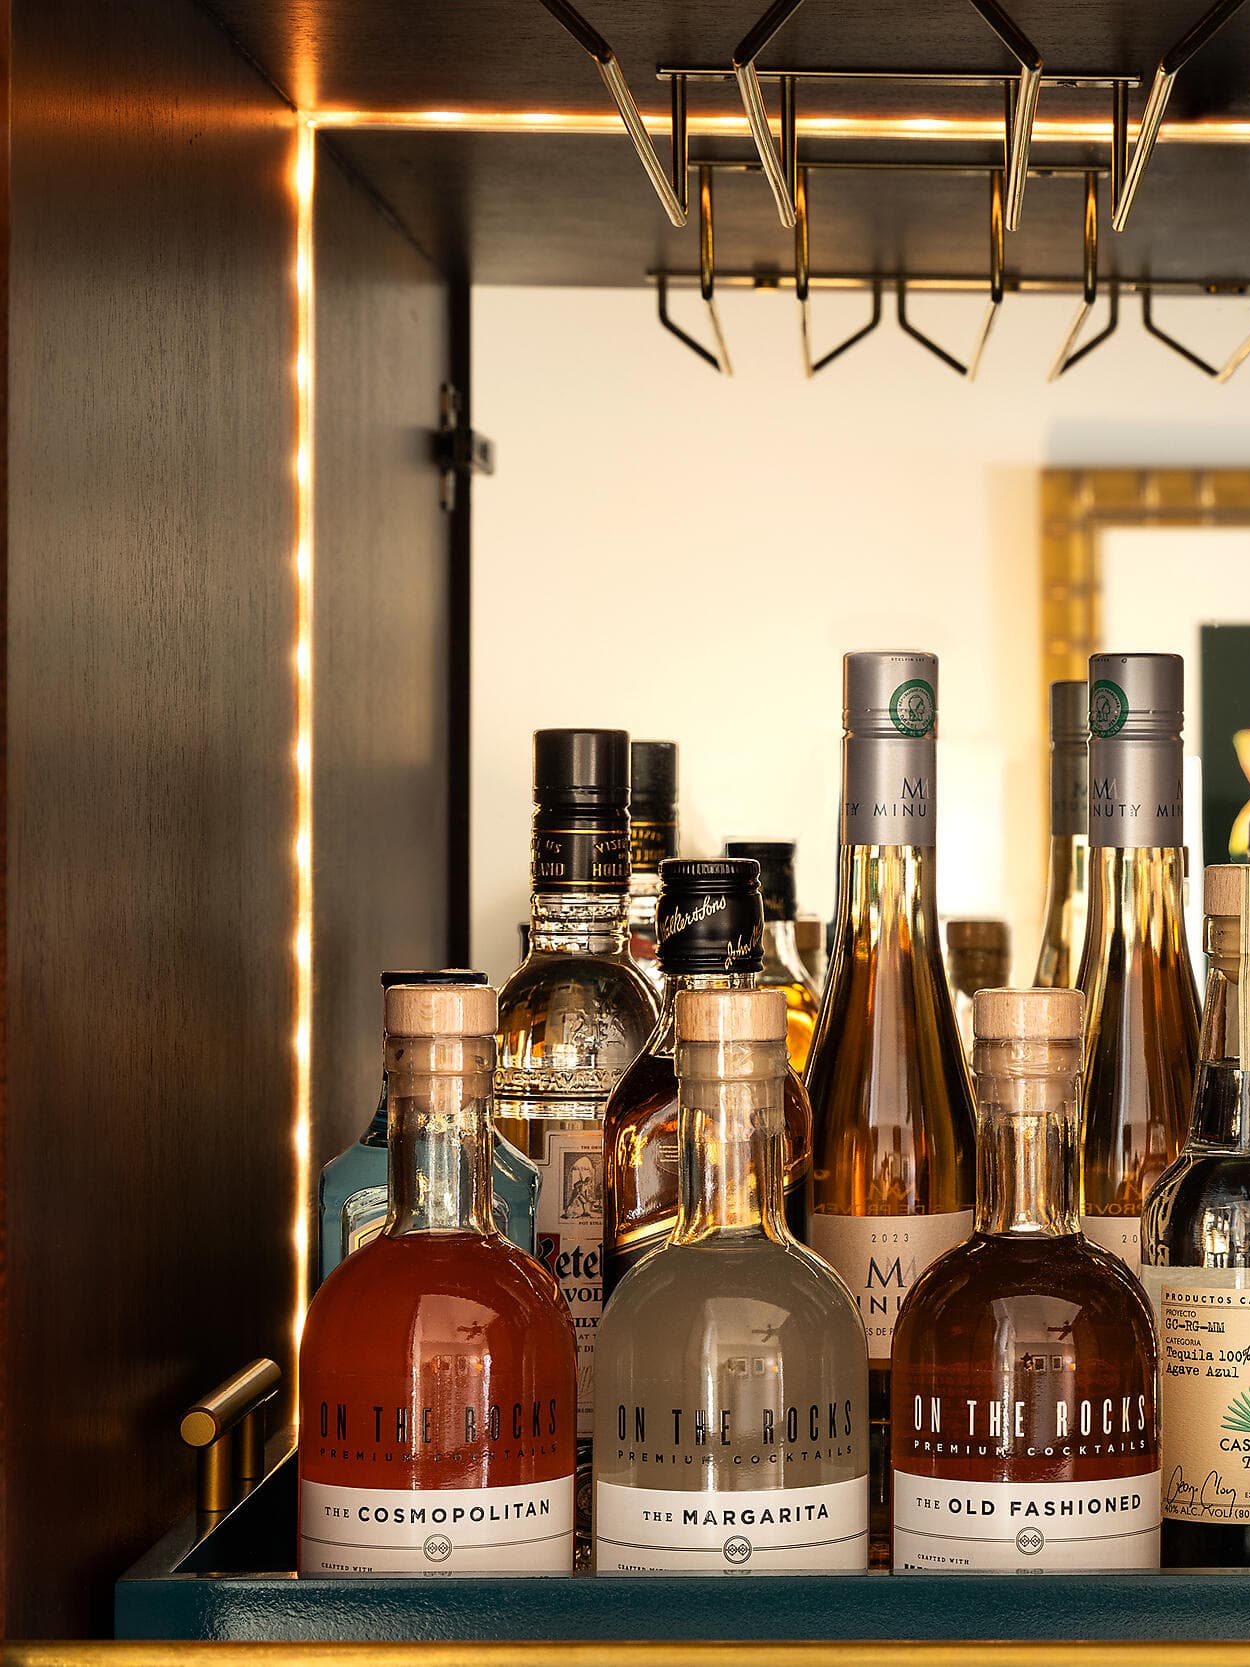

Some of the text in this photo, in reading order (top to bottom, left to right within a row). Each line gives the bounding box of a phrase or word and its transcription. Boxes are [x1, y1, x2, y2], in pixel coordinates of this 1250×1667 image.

[873, 803, 927, 817] MINU
[871, 1233, 909, 1243] 2023
[1121, 1234, 1138, 1244] 20
[1165, 1292, 1232, 1304] PRODUCTOS
[1165, 1308, 1197, 1318] PROYECTO
[876, 1327, 887, 1337] DE
[1166, 1346, 1214, 1362] Tequila
[1166, 1362, 1239, 1378] Agave Azul
[320, 1398, 557, 1443] ON THE ROCKS
[618, 1400, 852, 1446] ON THE ROCKS
[914, 1394, 1145, 1438] ON THE ROCKS
[320, 1442, 557, 1463] PREMIUM COCKTAILS
[618, 1445, 852, 1465] PREMIUM COCKTAILS
[914, 1439, 1145, 1457] PREMIUM COCKTAILS
[324, 1498, 550, 1524] THE COSMOPOLITAN
[916, 1494, 1141, 1517] THE OLD FASHIONED
[643, 1503, 829, 1526] THE MARGARITA
[1234, 1508, 1250, 1520] (80
[321, 1562, 349, 1571] CRAFTED
[917, 1553, 970, 1565] CRAFTED WITH
